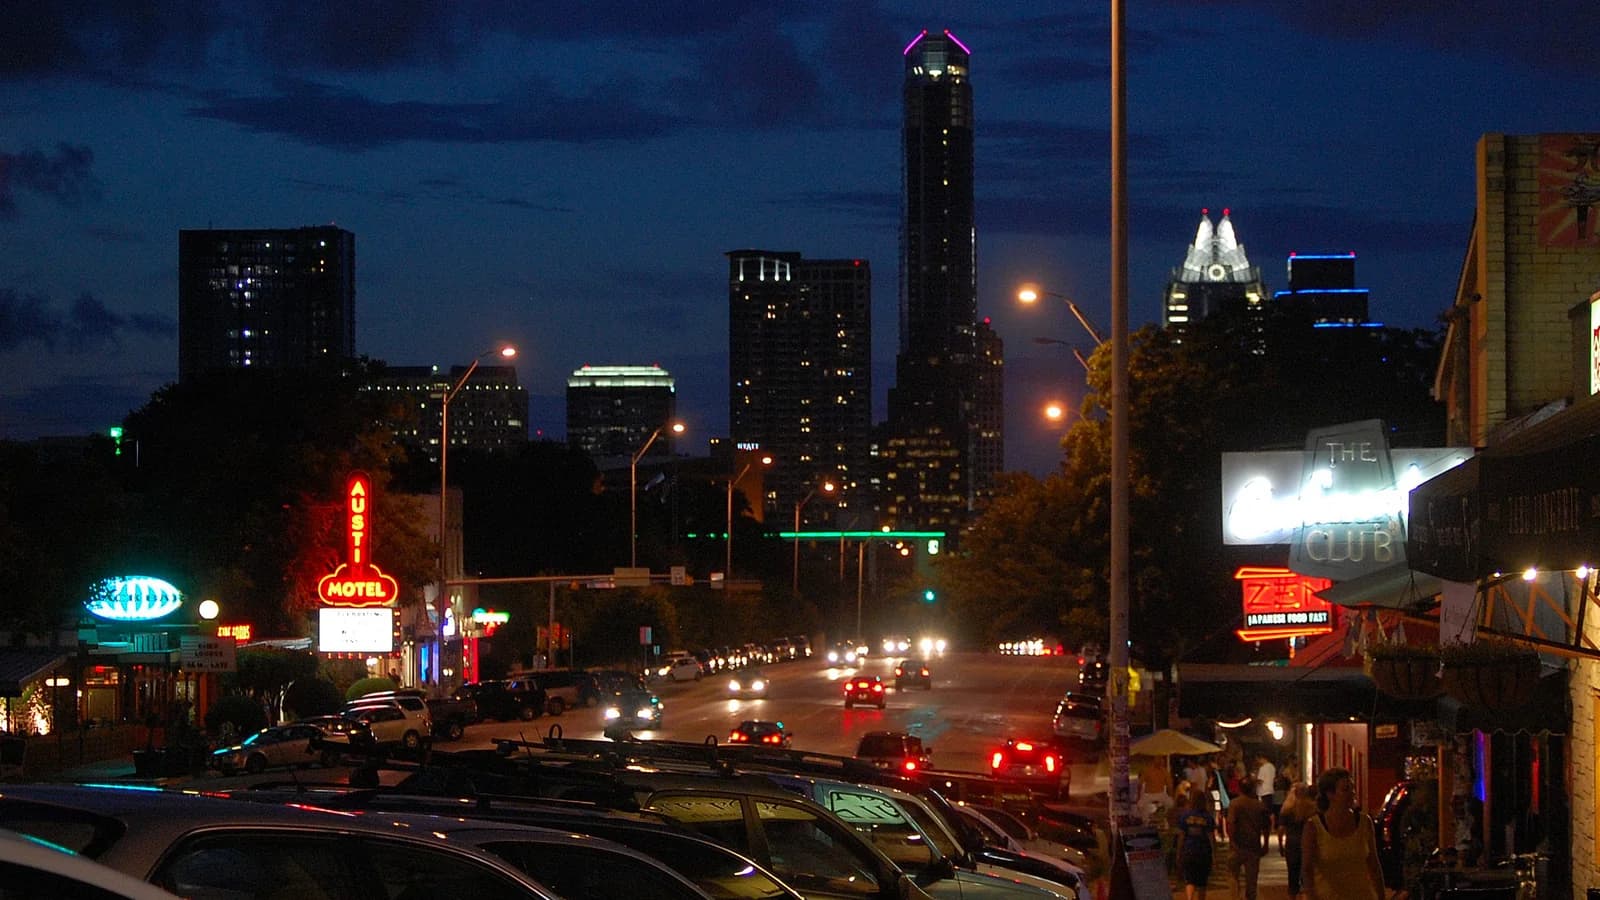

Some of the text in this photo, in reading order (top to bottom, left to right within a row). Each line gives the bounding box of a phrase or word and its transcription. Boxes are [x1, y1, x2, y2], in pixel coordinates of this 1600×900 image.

[737, 442, 759, 451] HYATT
[1326, 442, 1377, 463] THE
[1306, 530, 1393, 563] CLUB
[327, 581, 386, 598] MOTEL
[1247, 579, 1329, 609] ZEN
[1247, 611, 1328, 626] JAPANESE FOOD FAST
